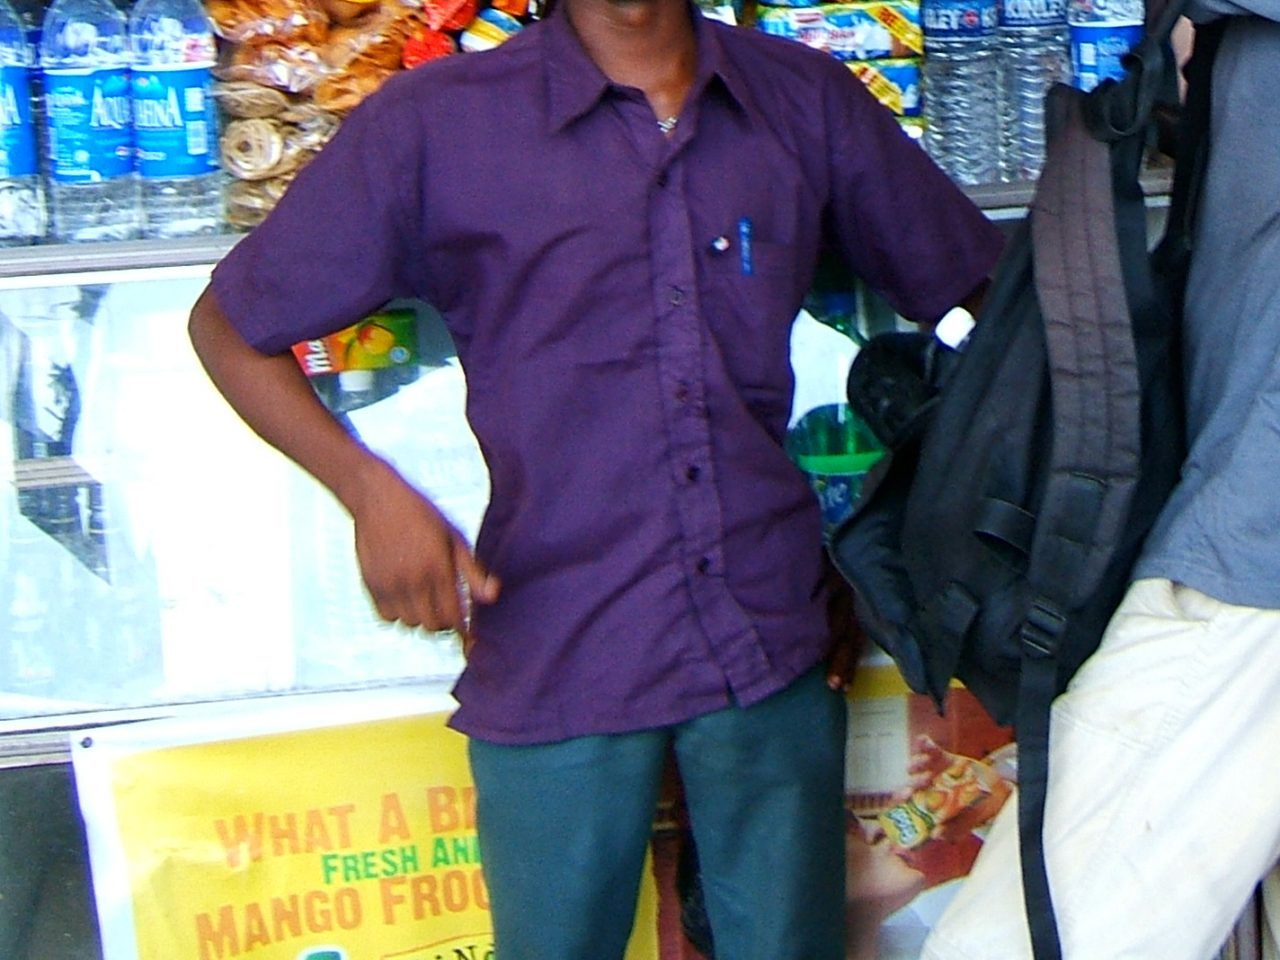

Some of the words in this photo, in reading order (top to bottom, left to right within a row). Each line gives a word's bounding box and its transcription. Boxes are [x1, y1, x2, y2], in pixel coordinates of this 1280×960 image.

[214, 804, 356, 869] WHAT
[378, 792, 410, 843] A
[321, 845, 419, 884] FRESH
[196, 887, 363, 960] MANGO
